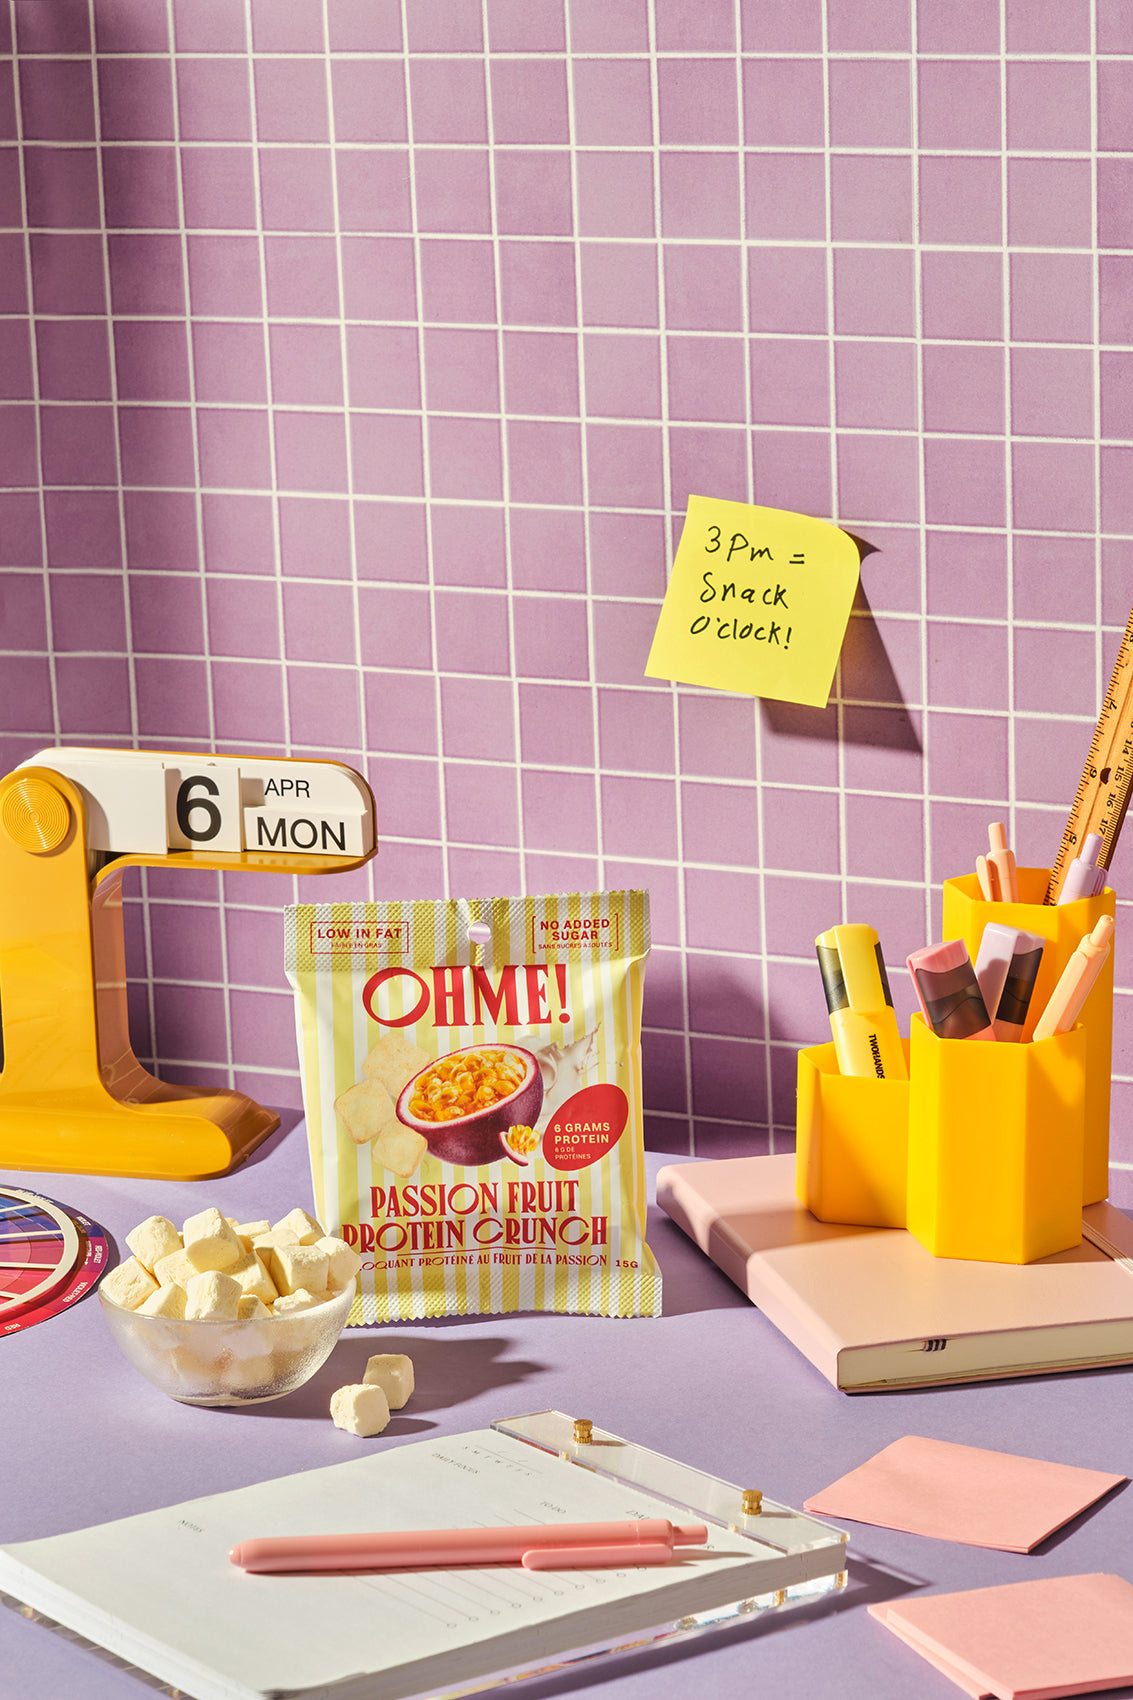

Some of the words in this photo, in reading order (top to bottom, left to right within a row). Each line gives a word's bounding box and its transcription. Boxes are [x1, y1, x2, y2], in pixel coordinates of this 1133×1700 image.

[789, 553, 805, 564] =
[700, 571, 788, 609] Snack
[1109, 700, 1118, 710] 7
[1122, 738, 1133, 755] 14
[1089, 768, 1098, 779] 6
[1114, 765, 1125, 782] 15
[264, 778, 311, 798] APR
[1106, 792, 1116, 809] 16
[176, 775, 222, 842] 6
[257, 816, 346, 851] MON
[1098, 818, 1109, 836] 17
[1069, 834, 1078, 846] 5
[540, 920, 559, 930] NO
[563, 918, 610, 930] ADDED
[317, 928, 351, 939] LOW
[356, 928, 370, 939] IN
[375, 928, 402, 939] FAT
[552, 930, 598, 941] SUGAR
[362, 964, 571, 1028] OHME!
[554, 1124, 561, 1133] 6
[565, 1122, 610, 1133] GRAMS
[554, 1134, 609, 1144] PROTEIN
[370, 1182, 499, 1218] PASSION
[507, 1180, 579, 1214] FRUIT
[342, 1220, 465, 1253] PROTEIN
[473, 1216, 607, 1246] CRUNCH
[477, 1254, 490, 1265] AU
[493, 1253, 522, 1265] FRUIT
[525, 1253, 537, 1264] DE
[540, 1253, 552, 1264] LA
[556, 1254, 608, 1266] PASSION
[615, 1259, 639, 1269] 15G
